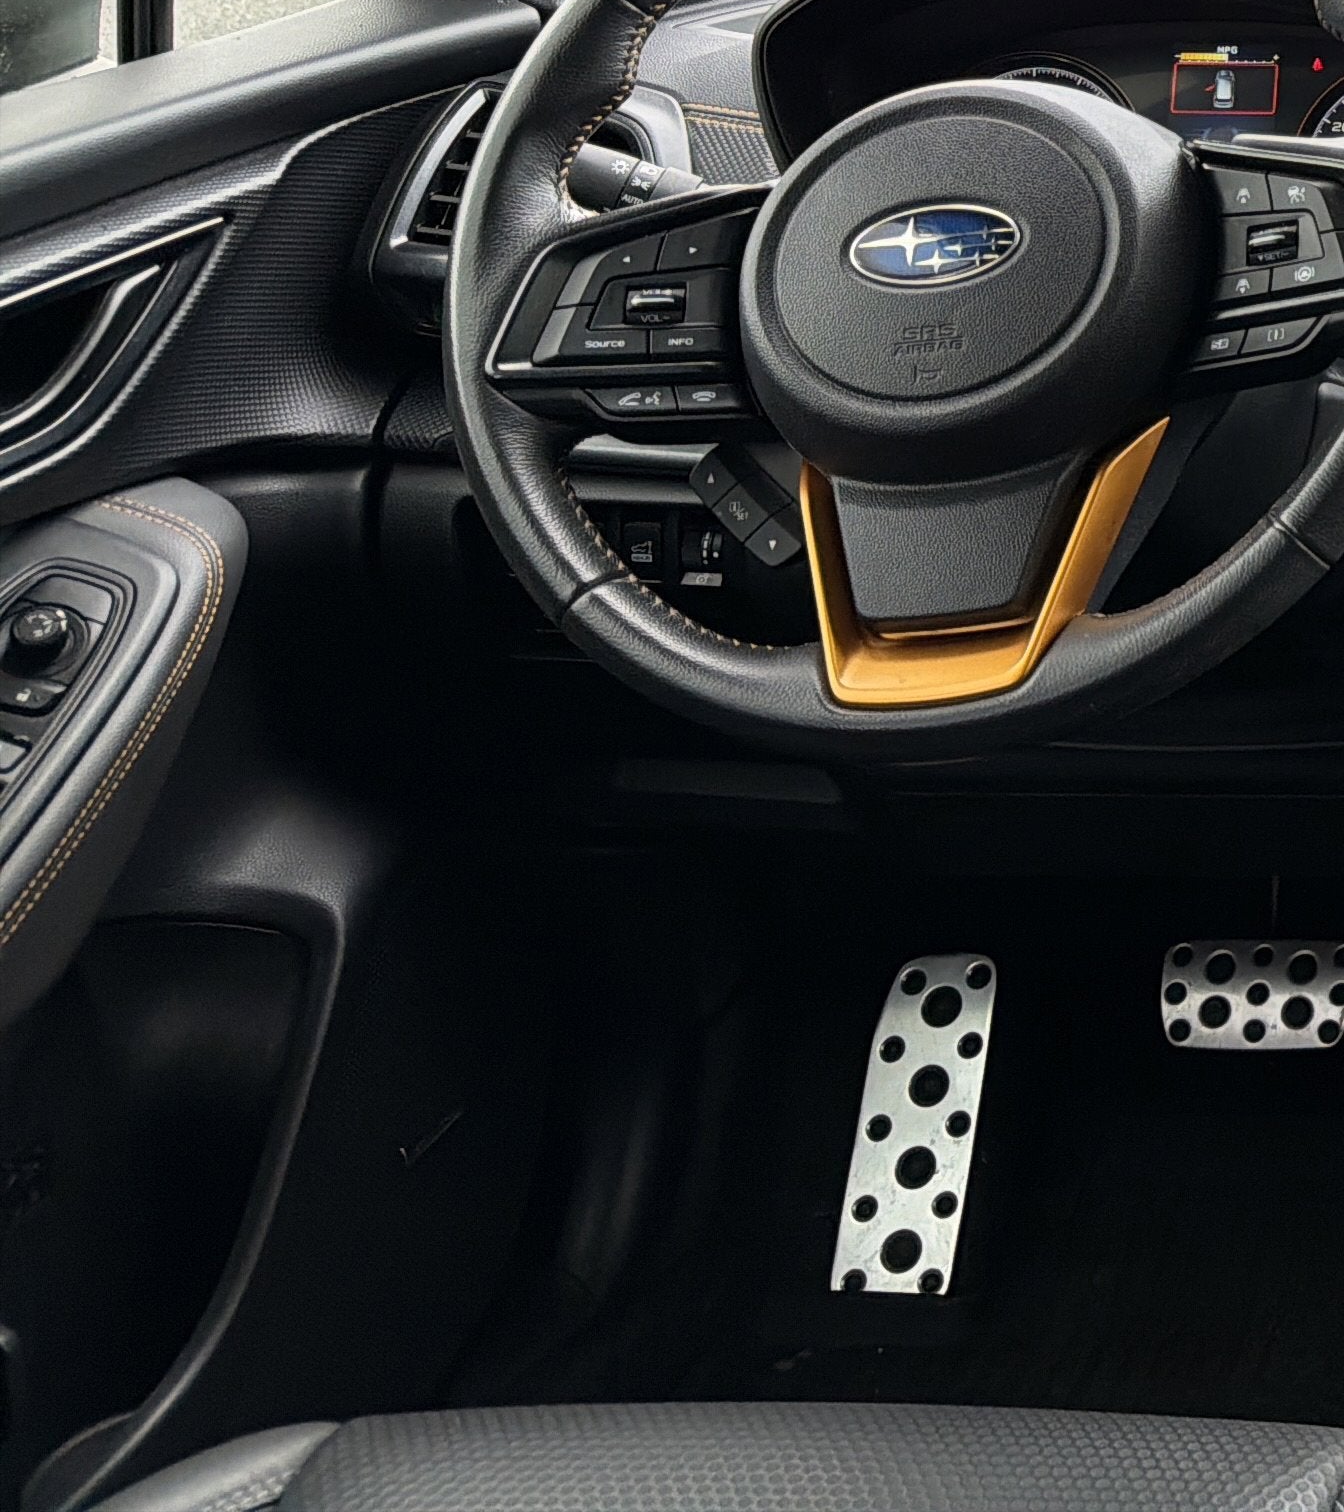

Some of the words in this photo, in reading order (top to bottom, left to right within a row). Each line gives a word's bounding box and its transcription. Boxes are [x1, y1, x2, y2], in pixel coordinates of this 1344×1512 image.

[1216, 45, 1238, 55] MPG
[585, 340, 625, 349] Source
[667, 338, 694, 346] INFO
